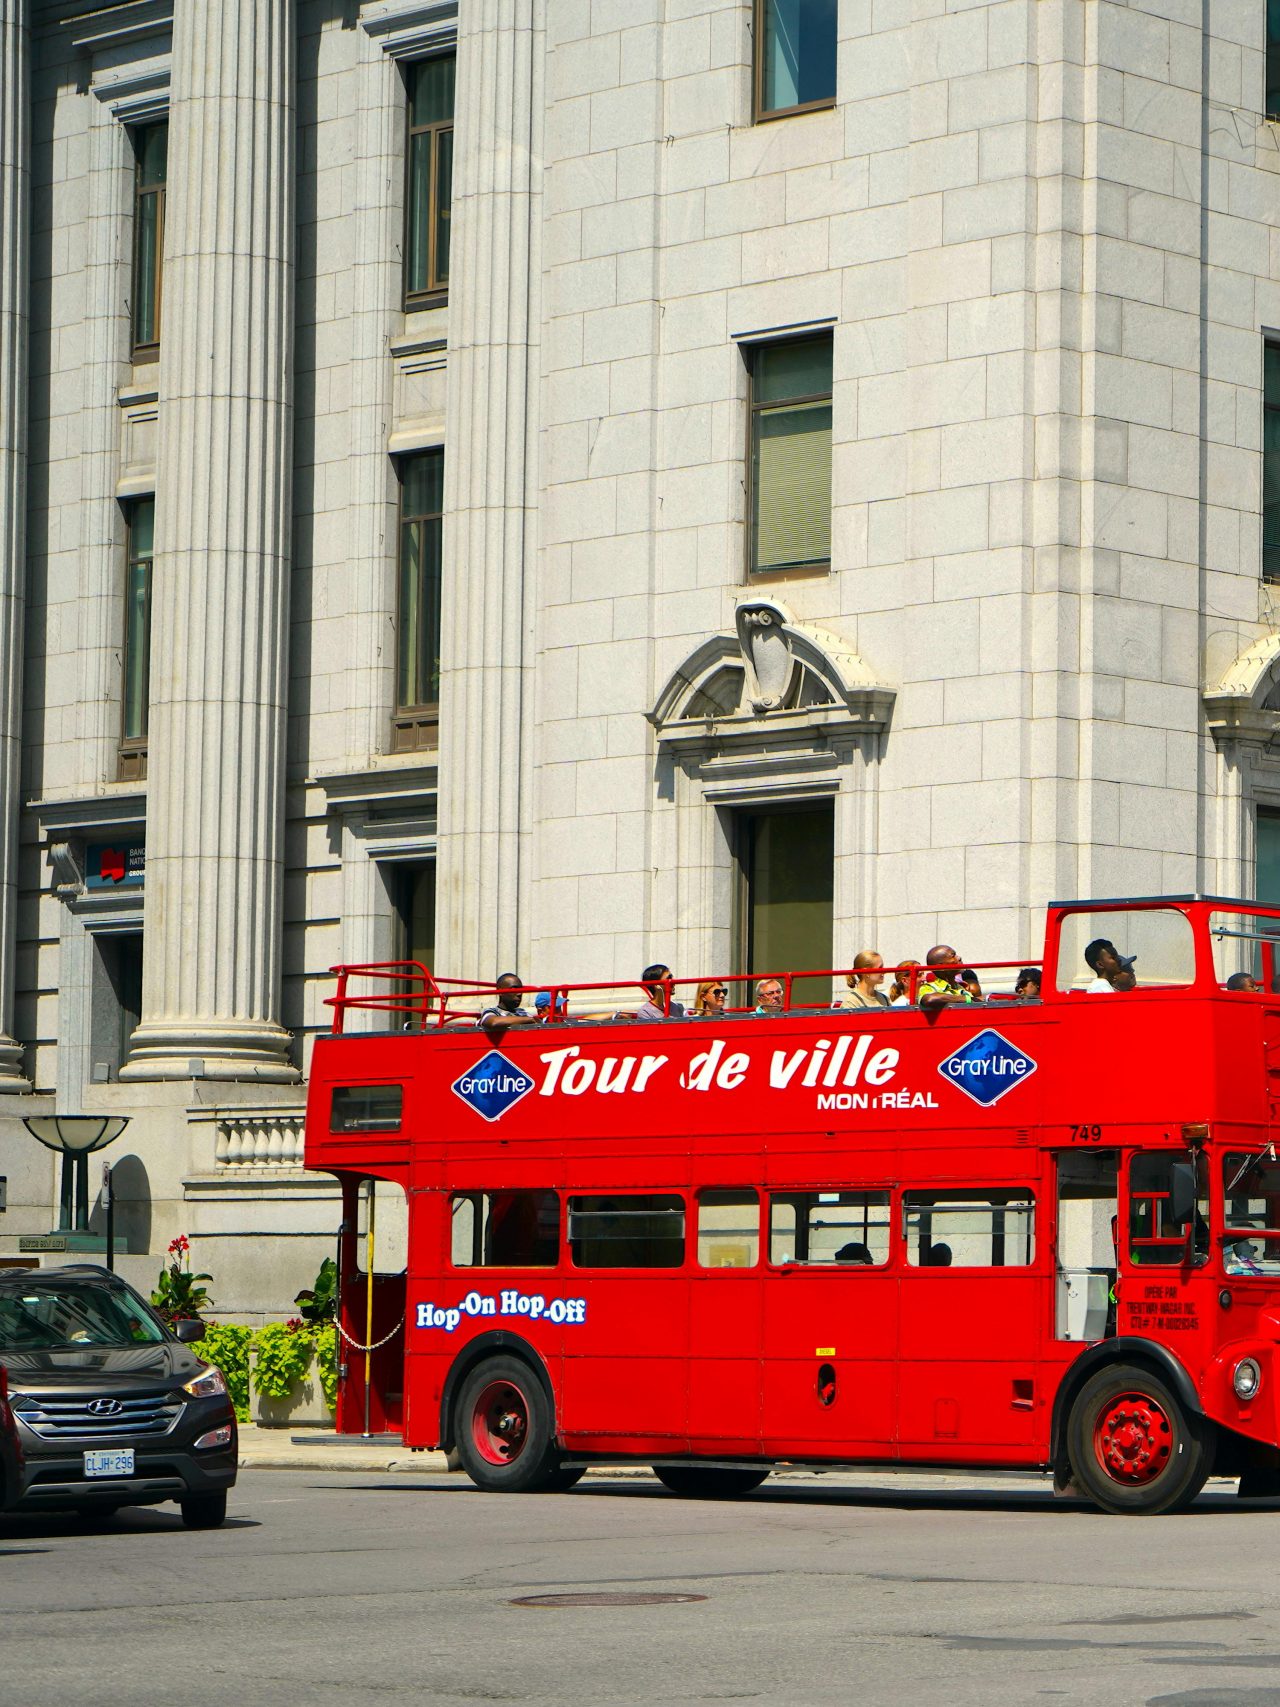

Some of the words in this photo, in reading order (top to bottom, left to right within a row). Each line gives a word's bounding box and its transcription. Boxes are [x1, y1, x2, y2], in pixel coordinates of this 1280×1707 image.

[539, 1045, 669, 1096] Tour
[679, 1040, 750, 1091] de
[769, 1035, 900, 1089] ville
[1071, 1125, 1102, 1142] 749
[416, 1292, 496, 1331] Hop-On
[500, 1291, 586, 1323] Hop-Off
